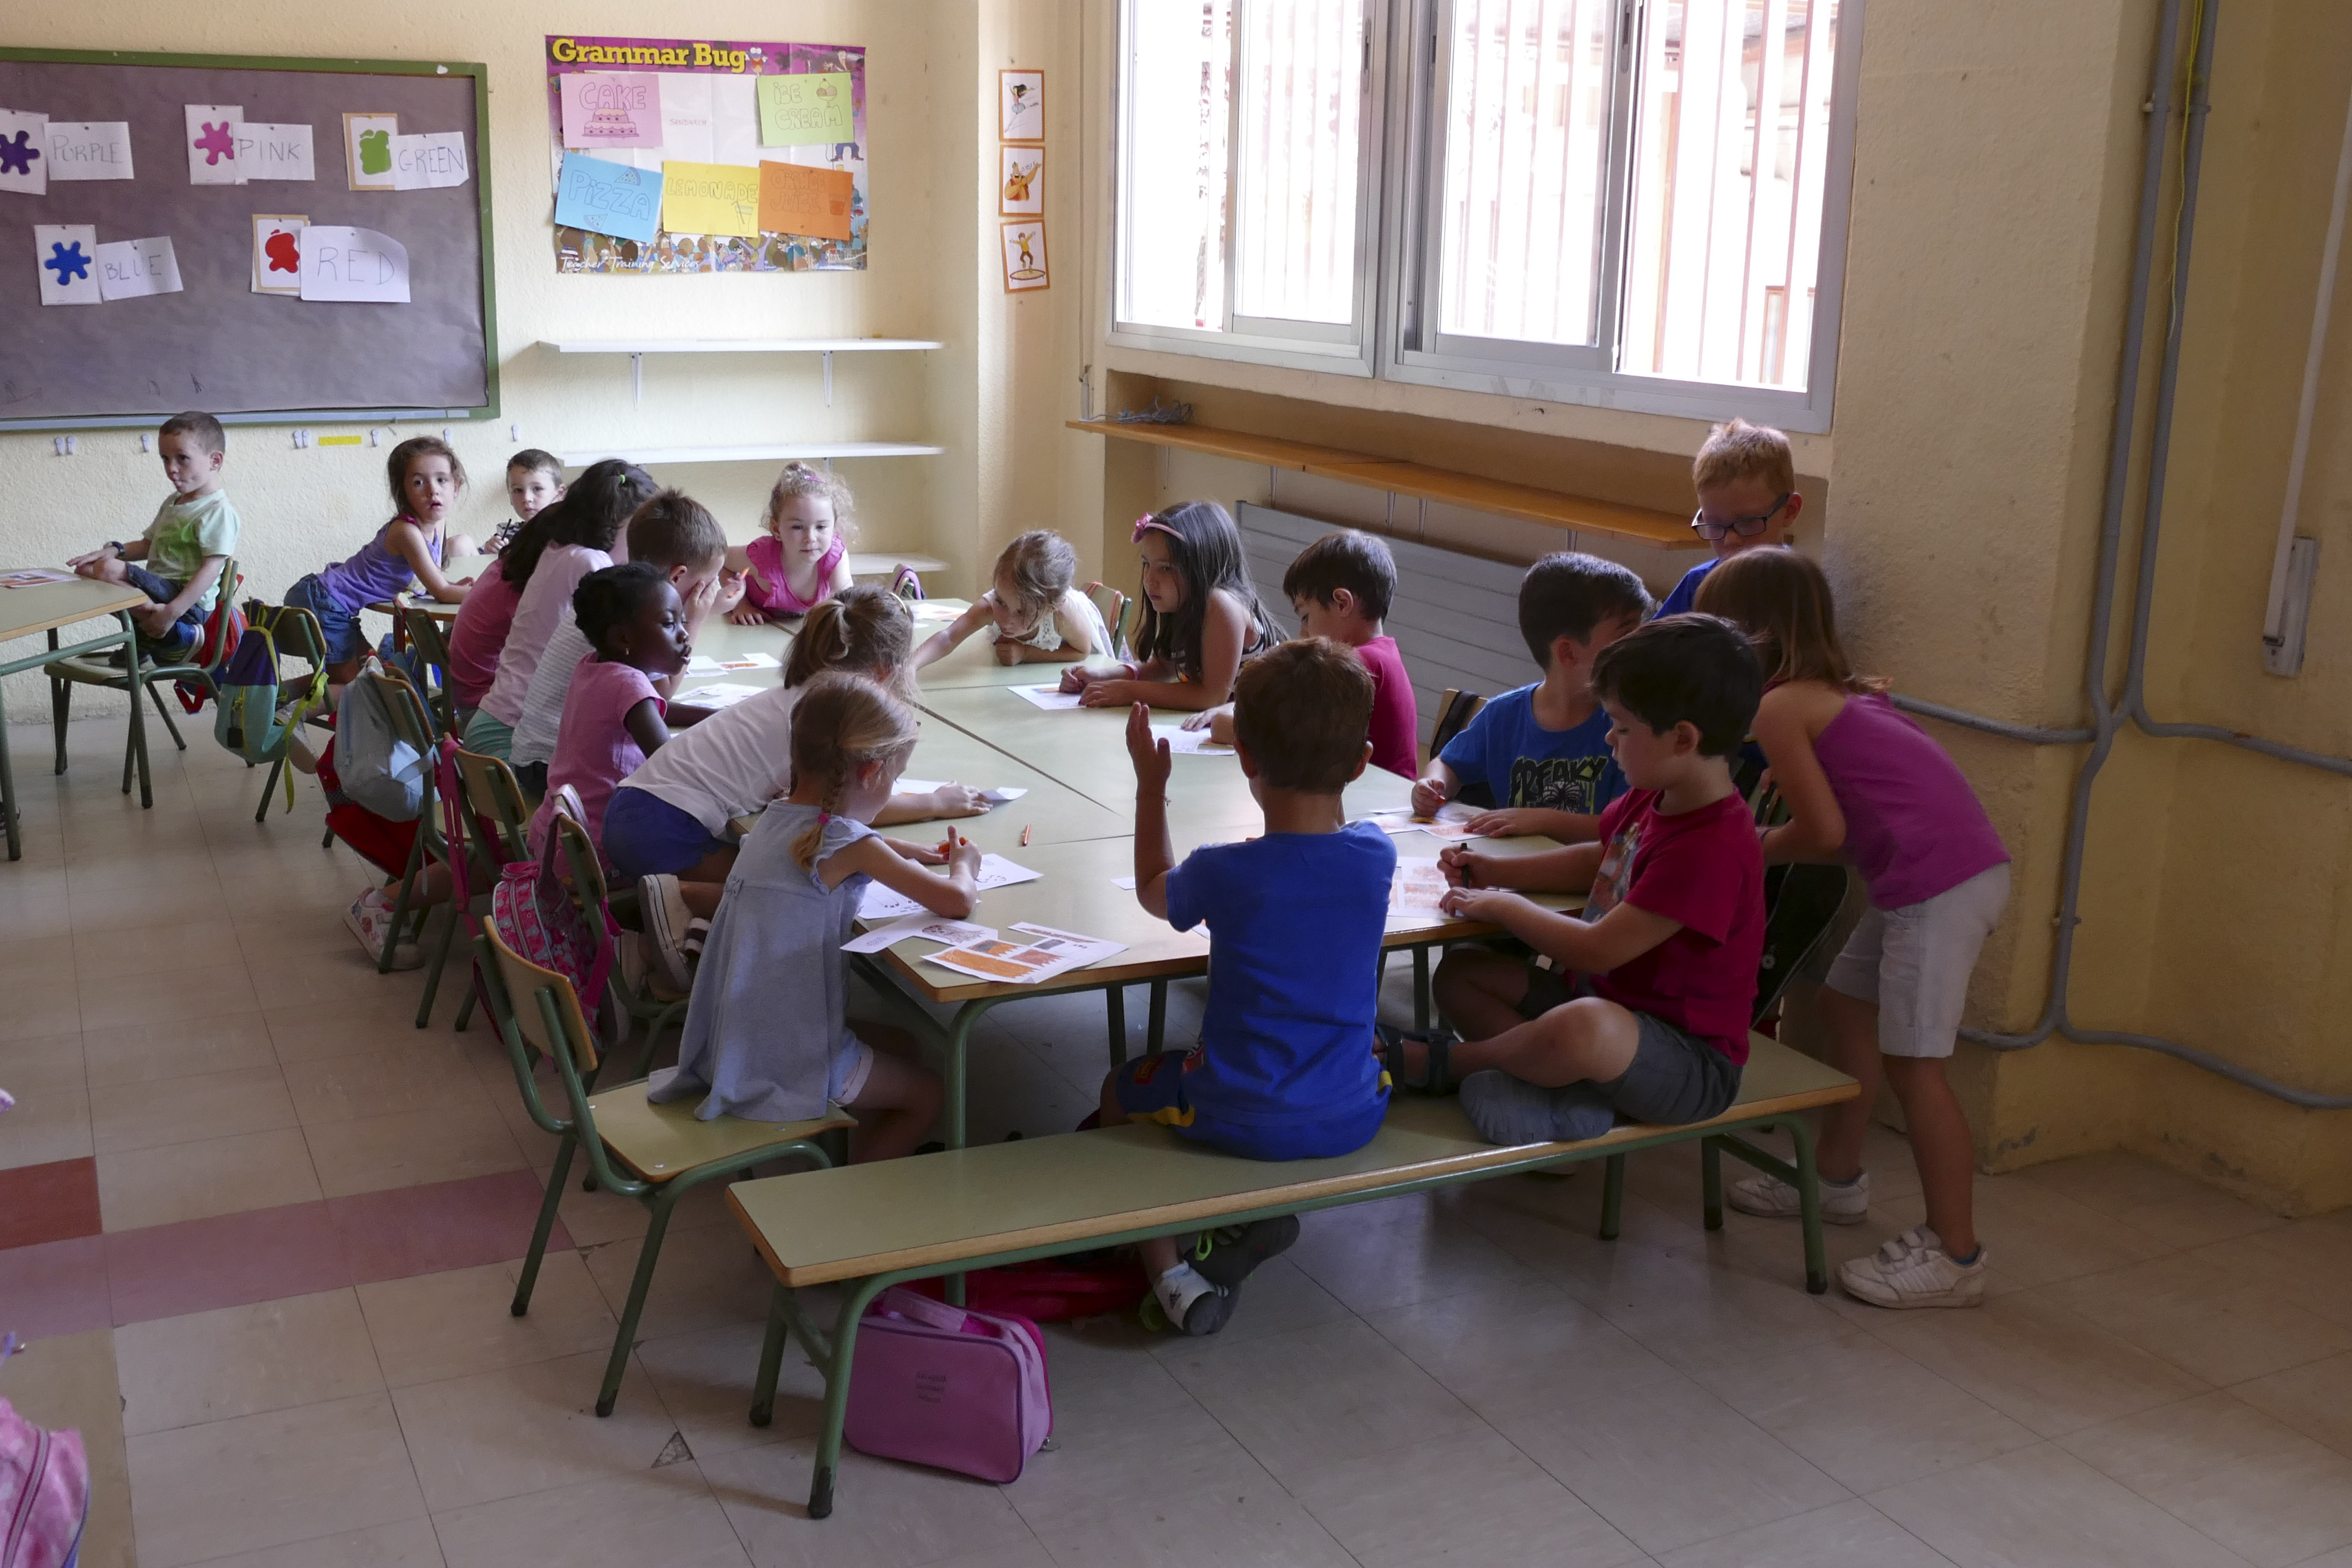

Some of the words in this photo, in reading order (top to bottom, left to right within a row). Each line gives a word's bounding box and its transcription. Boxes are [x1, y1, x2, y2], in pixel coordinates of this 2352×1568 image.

[552, 39, 689, 66] Grammar
[694, 42, 746, 73] Bug
[579, 82, 646, 110] CAKE
[775, 105, 842, 130] CREAM
[52, 135, 123, 164] PURPLE
[238, 138, 302, 161] PINK
[398, 146, 465, 174] GREEN
[666, 177, 758, 203] LEMONADE
[771, 168, 826, 193] ORANGE
[104, 254, 162, 280] BLUE
[317, 246, 395, 286] RED
[561, 256, 604, 273] Teacher
[608, 256, 655, 273] Training
